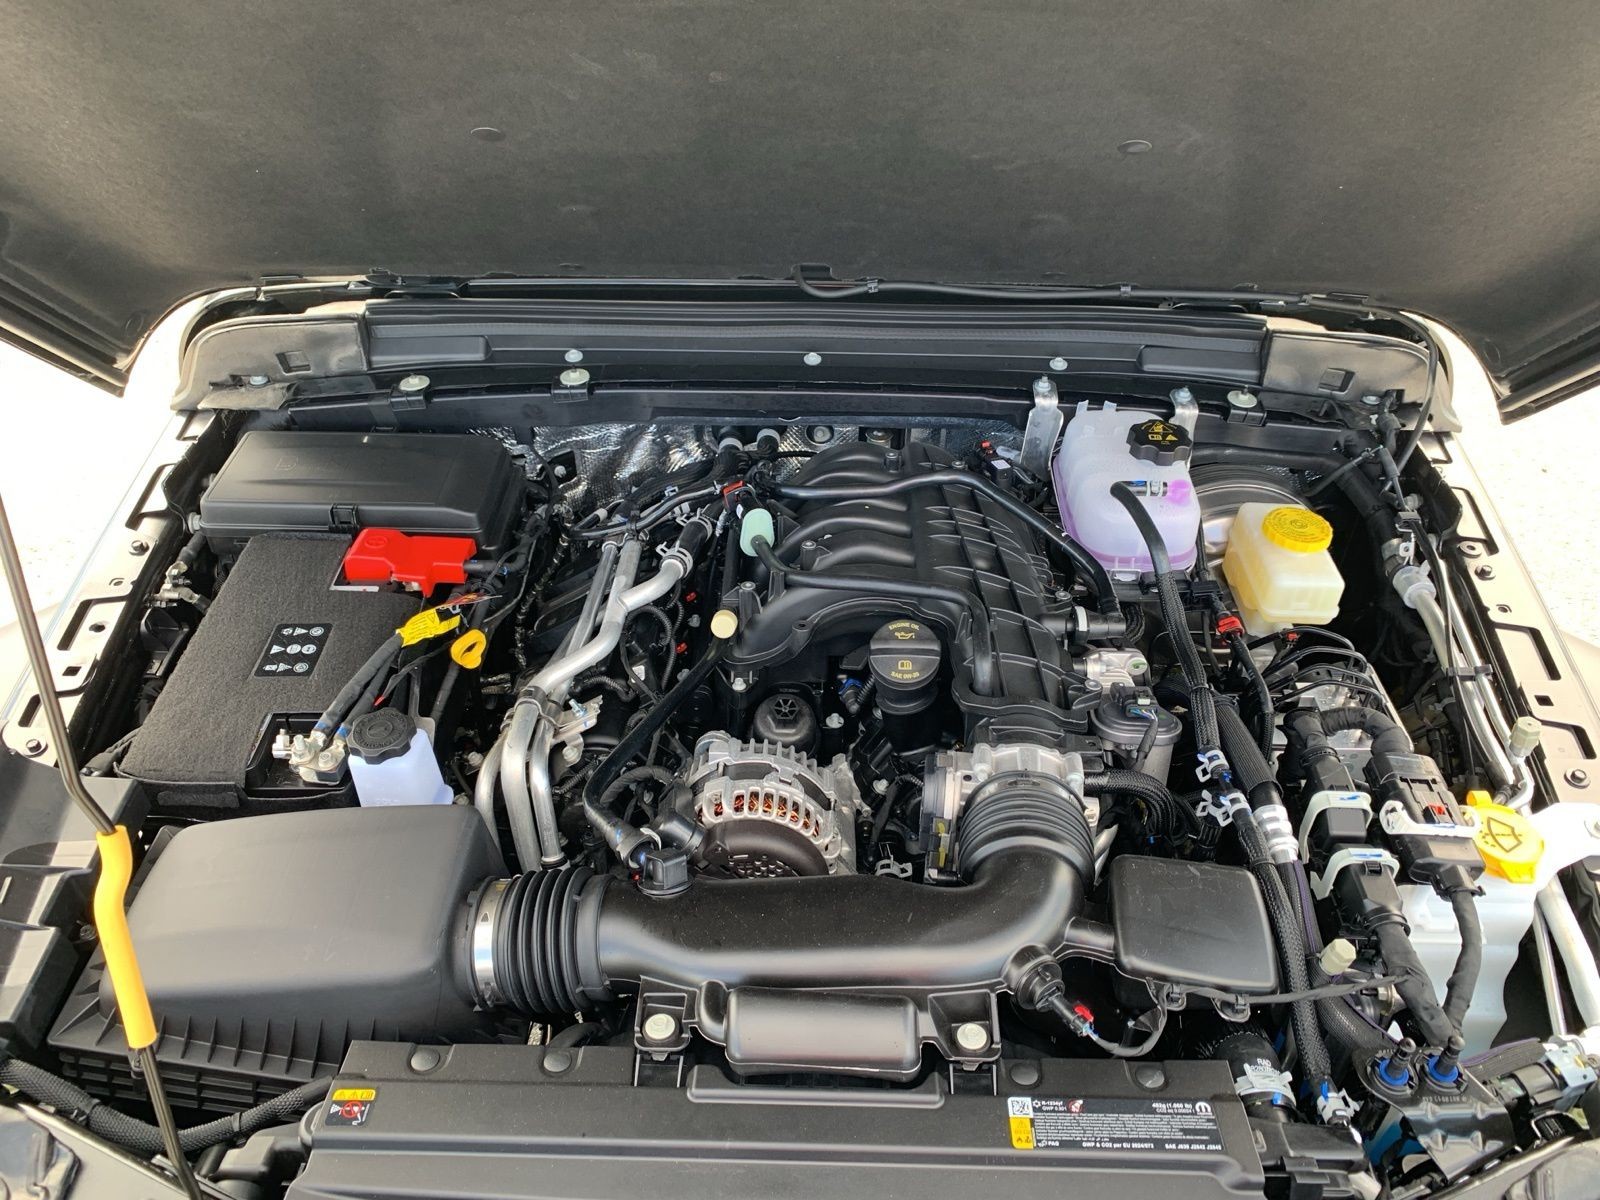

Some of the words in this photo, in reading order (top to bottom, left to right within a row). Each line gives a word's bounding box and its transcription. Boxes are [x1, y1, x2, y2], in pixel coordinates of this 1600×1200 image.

[888, 622, 910, 631] ENGINE
[911, 623, 920, 631] OIL
[890, 671, 902, 679] SAE
[1256, 1057, 1272, 1067] RAD
